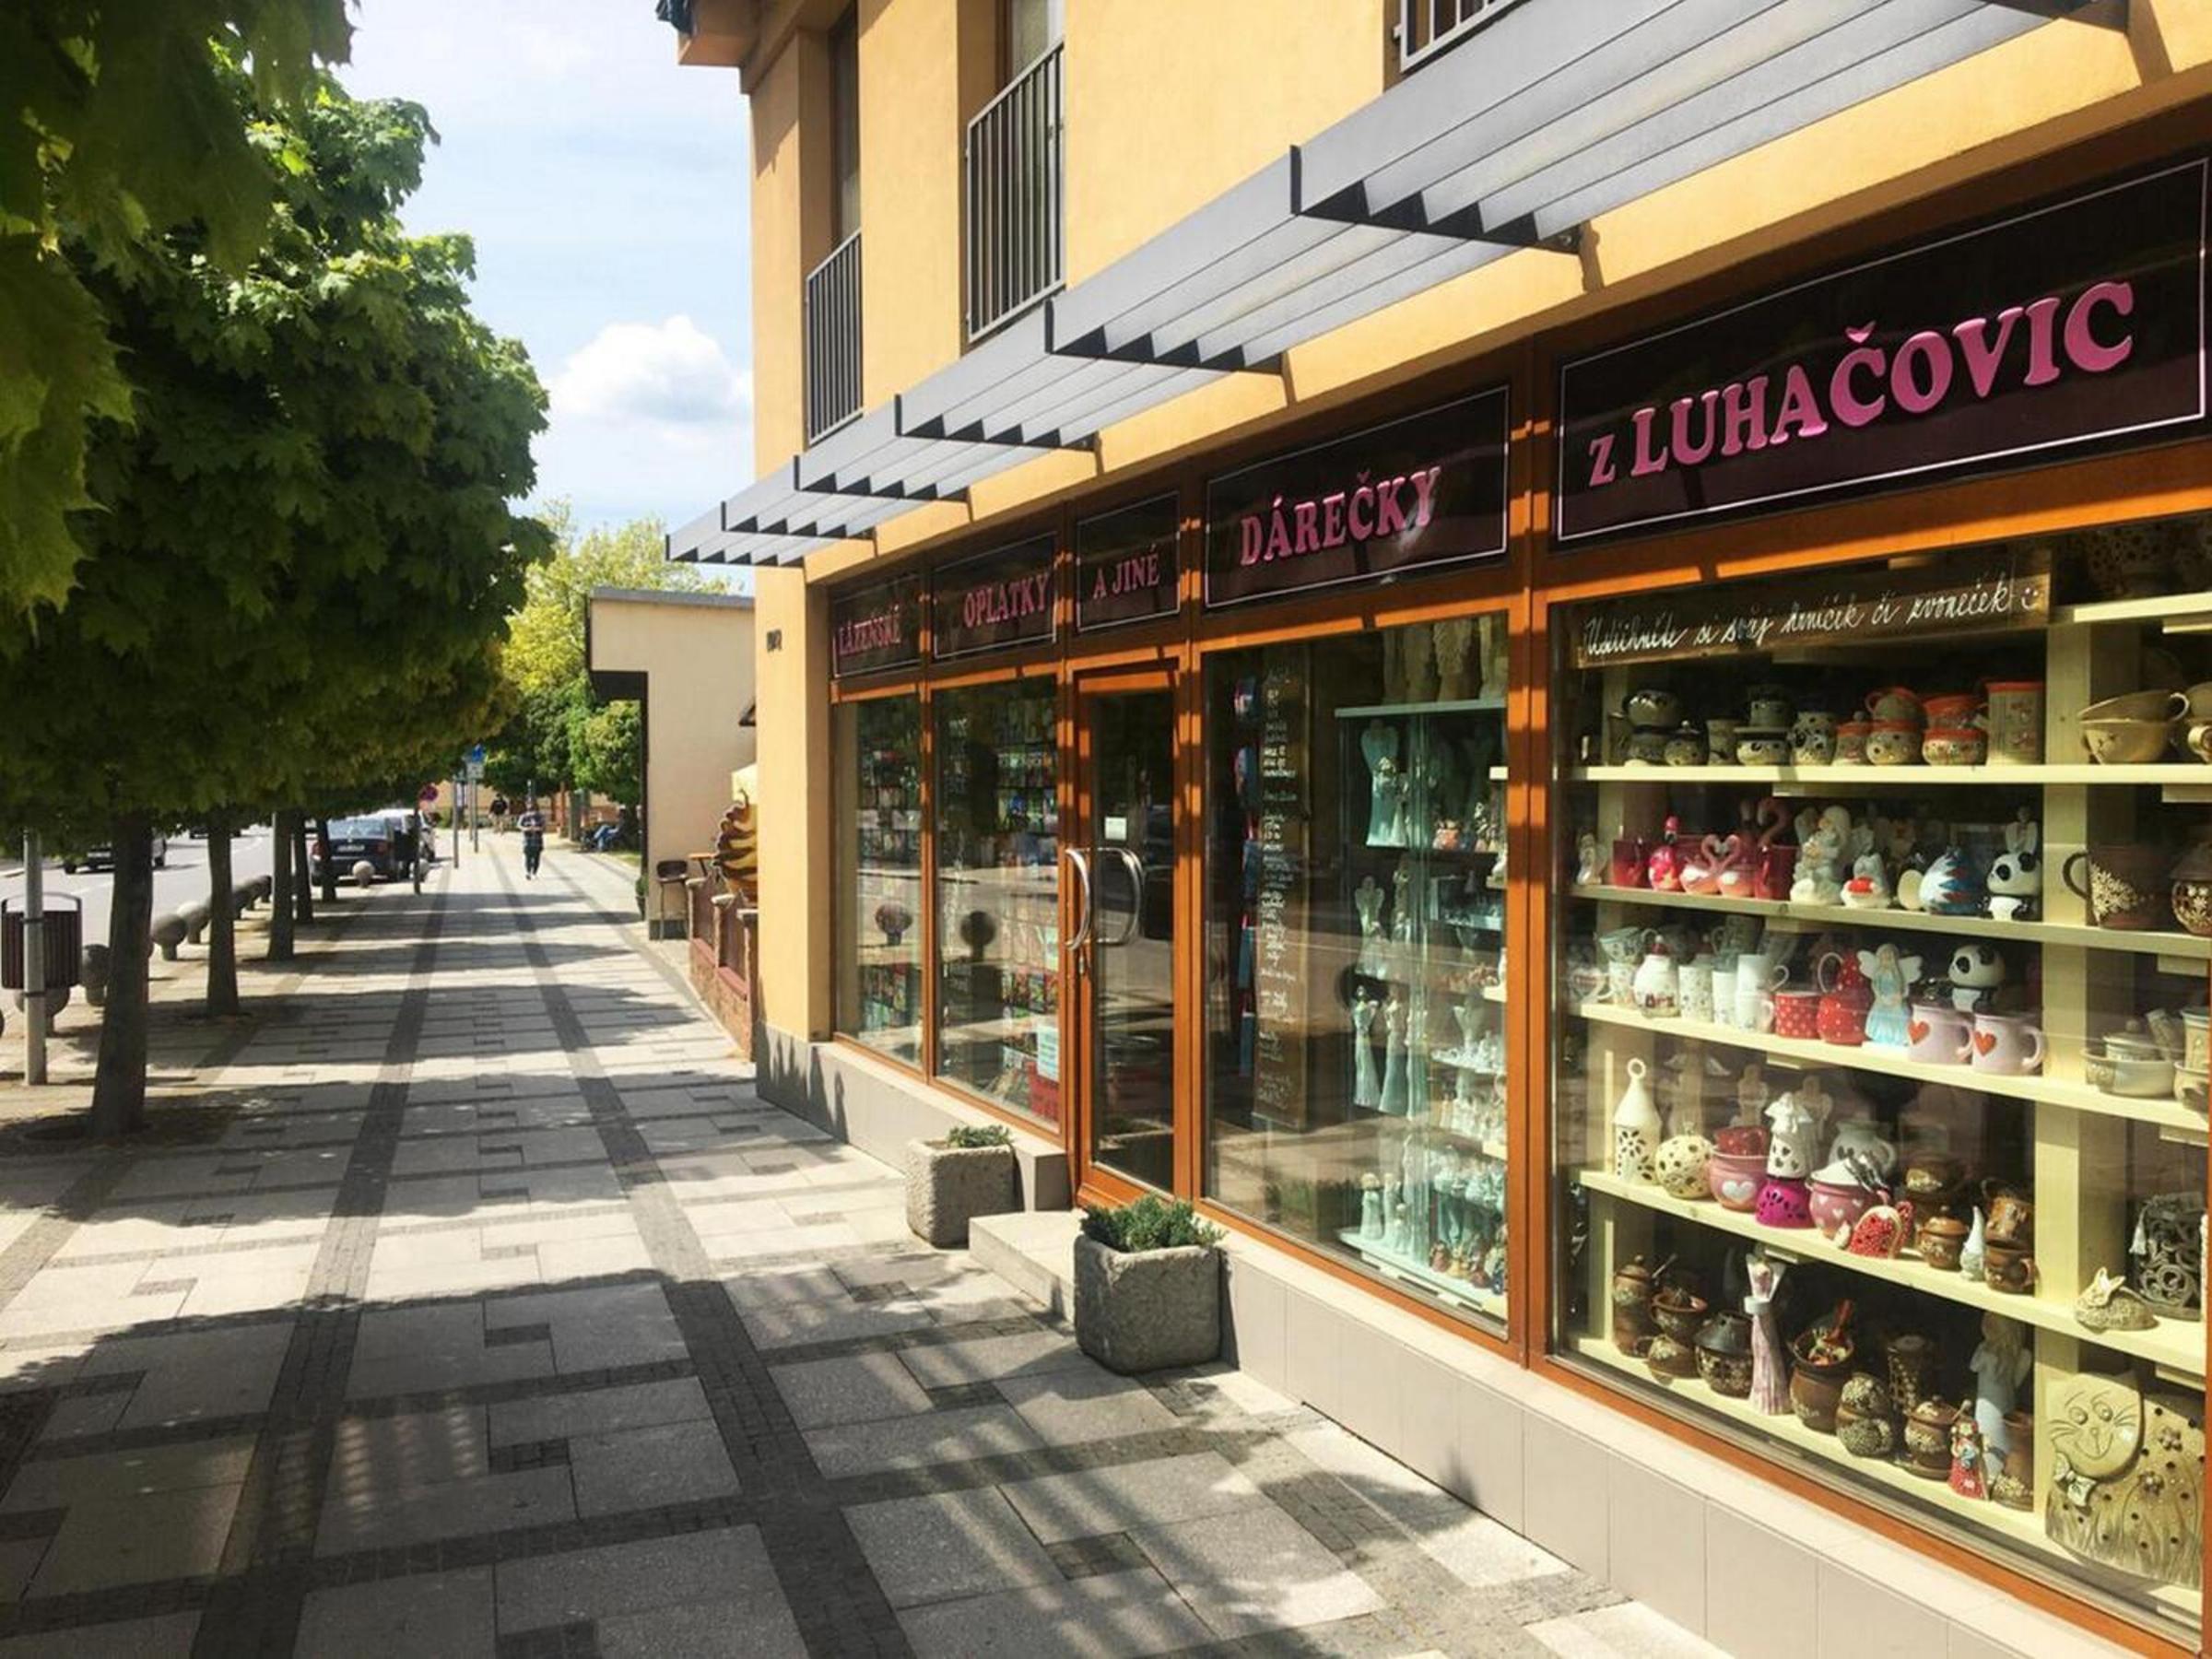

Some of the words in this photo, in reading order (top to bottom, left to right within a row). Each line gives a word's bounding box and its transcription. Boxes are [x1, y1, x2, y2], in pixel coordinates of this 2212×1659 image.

[1630, 281, 2135, 477] LUHAČOVIC
[1240, 465, 1441, 566] DÁREČKY
[963, 571, 1051, 629] OPLATKY
[1092, 567, 1107, 600] A
[1112, 542, 1160, 594] JINÉ
[1693, 612, 1720, 645] si
[1720, 604, 1775, 648] svůj
[1870, 588, 1902, 625] či
[1905, 570, 2010, 625] zvoneček
